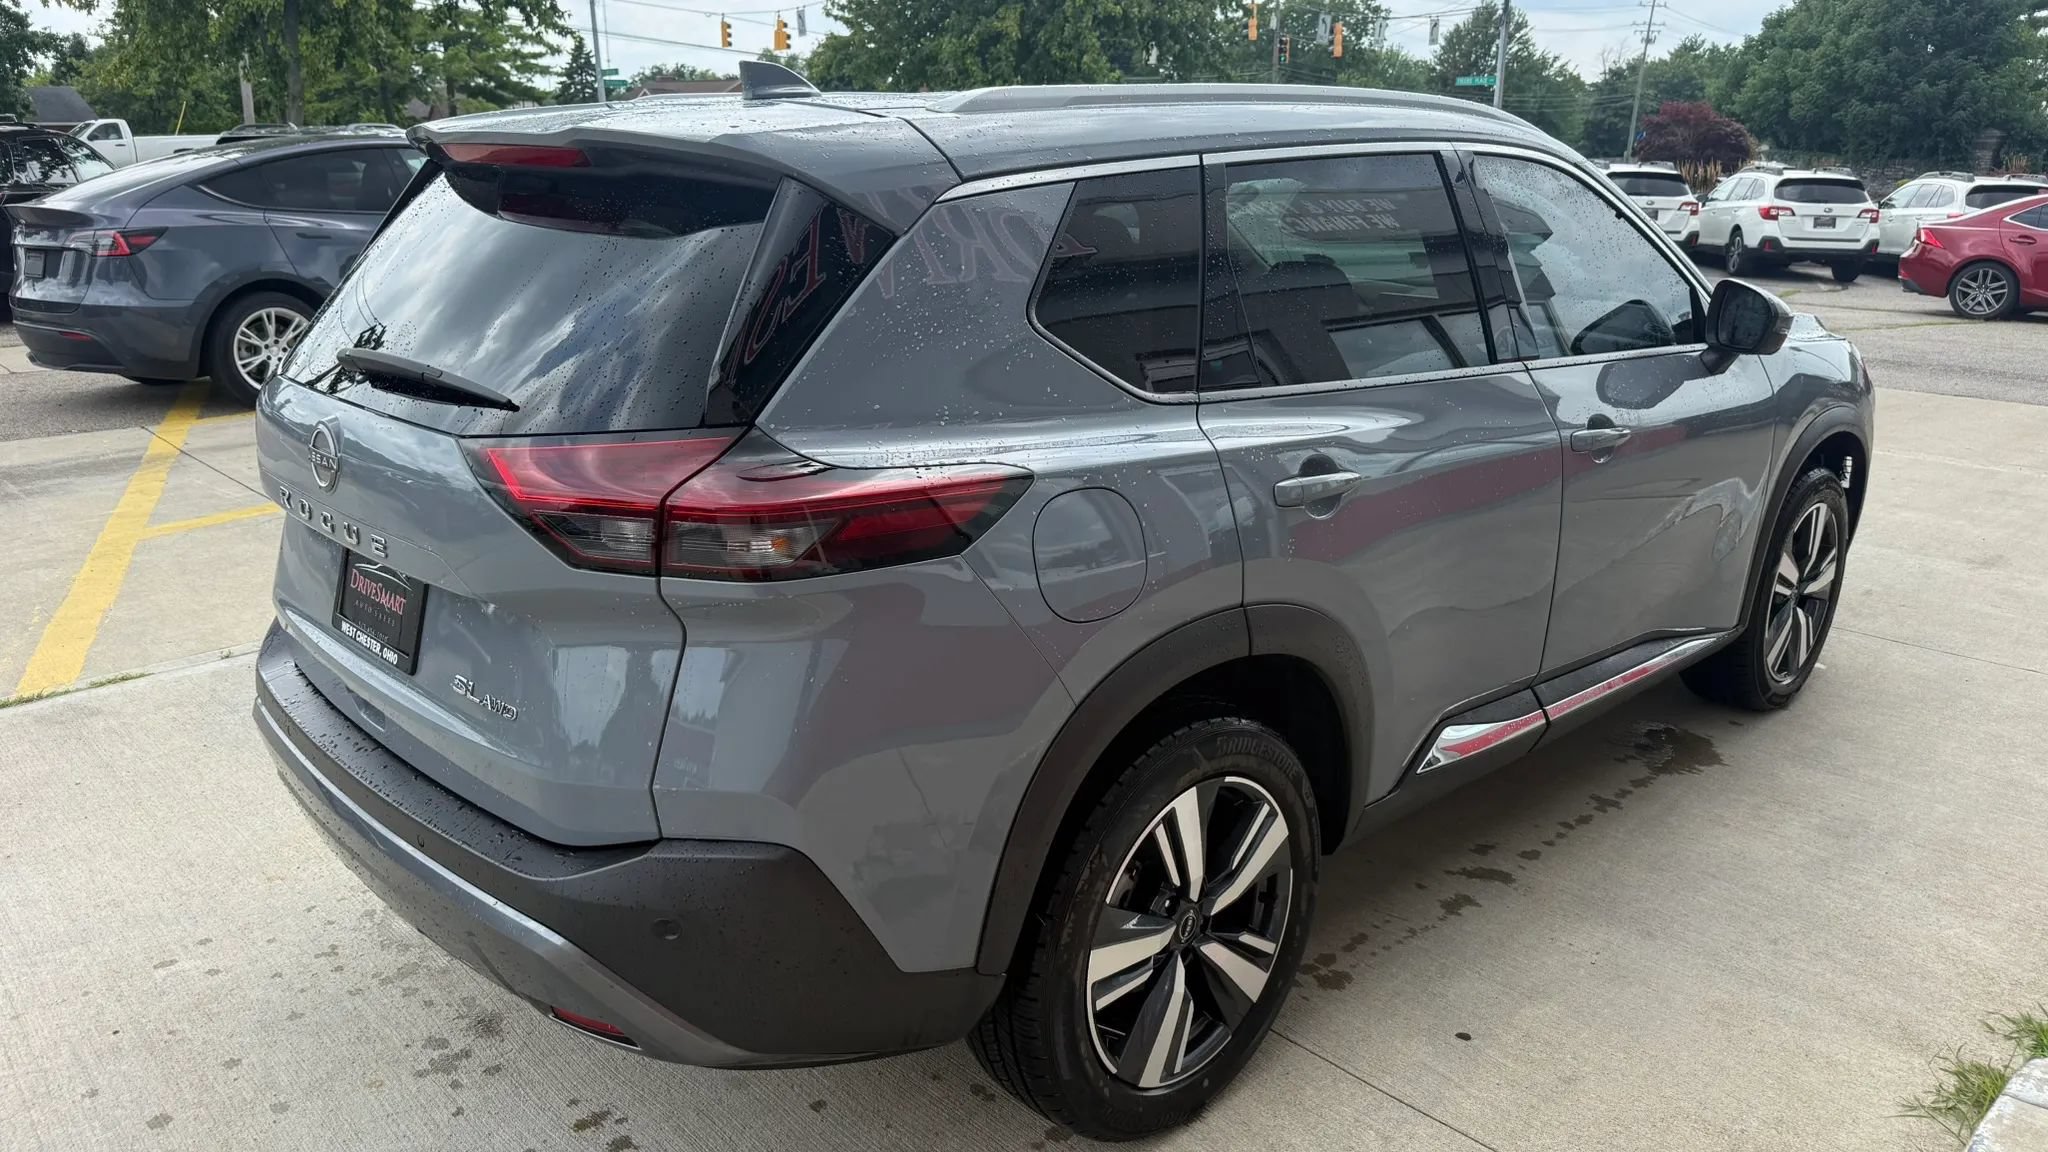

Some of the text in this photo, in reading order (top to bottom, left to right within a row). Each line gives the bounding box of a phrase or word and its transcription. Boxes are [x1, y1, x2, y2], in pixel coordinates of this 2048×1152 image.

[279, 486, 388, 559] ROGUE
[341, 620, 357, 639] WEST
[356, 628, 382, 657] CHESTER,
[382, 647, 398, 665] OHIO
[450, 674, 517, 721] SL AWD
